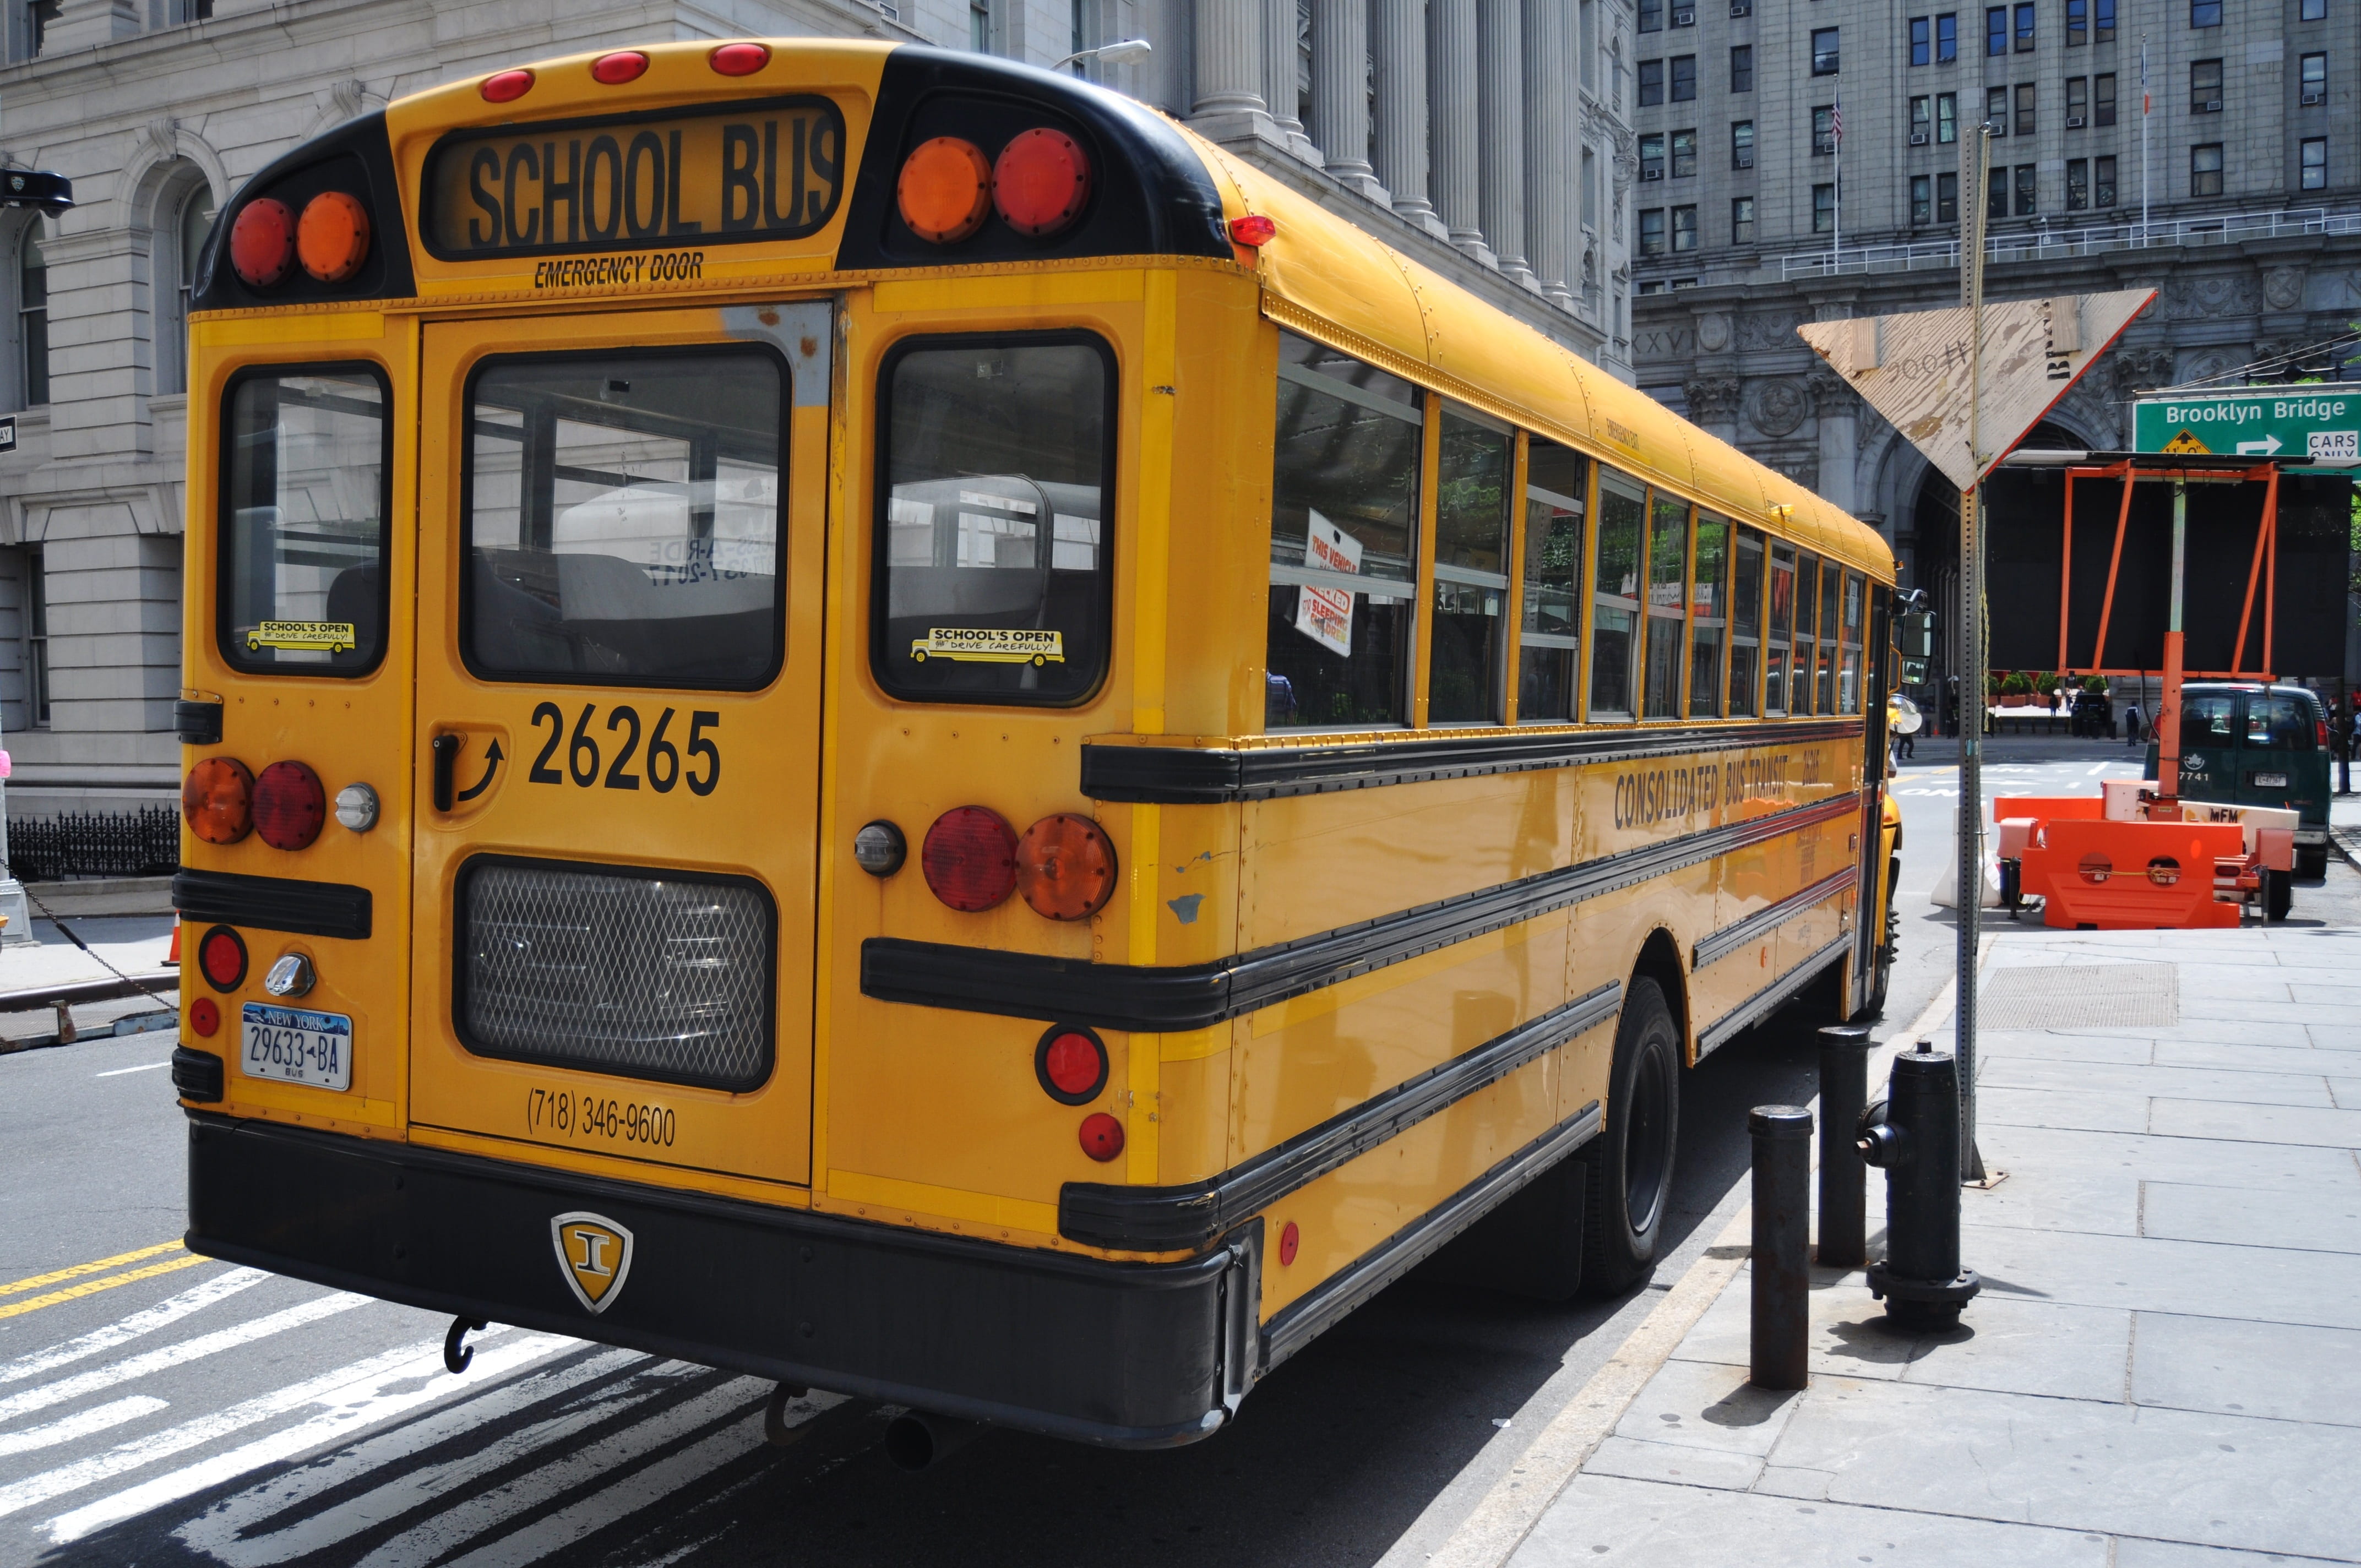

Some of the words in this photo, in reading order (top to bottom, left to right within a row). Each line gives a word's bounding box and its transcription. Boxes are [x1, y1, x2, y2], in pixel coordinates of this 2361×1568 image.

[469, 129, 701, 249] SCHOOL
[721, 115, 835, 232] BUS
[534, 255, 647, 288] EMERGENCY
[650, 251, 704, 282] DOOR
[2166, 403, 2261, 424] Brooklyn
[2274, 399, 2346, 421] Bridge
[2309, 434, 2355, 448] CARS
[1312, 535, 1328, 560] THIS
[1329, 546, 1357, 574] VEHICLE
[1309, 585, 1348, 611] ECKED
[264, 623, 317, 631] SCHOOL'S
[319, 624, 349, 633] OPEN
[1310, 612, 1347, 644] CHLDREN
[1312, 599, 1348, 631] SLEEPING
[302, 633, 348, 641] CAREFULLY!
[934, 629, 1008, 641] SCHOOL'S
[1013, 631, 1055, 643] OPEN
[989, 641, 1053, 652] CAREFULLY!
[529, 701, 720, 797] 26265
[2179, 771, 2209, 781] 7741
[1614, 764, 1718, 830] CONSOLIDATED
[1725, 760, 1746, 805] BUS
[1749, 755, 1788, 801] TRANSIT
[268, 1010, 292, 1027] NEW
[295, 1014, 324, 1031] YORK
[251, 1026, 304, 1068] 29633
[318, 1035, 338, 1074] BA
[285, 1068, 303, 1078] BUS
[527, 1087, 576, 1138] (718)
[583, 1096, 676, 1147] 346-9600
